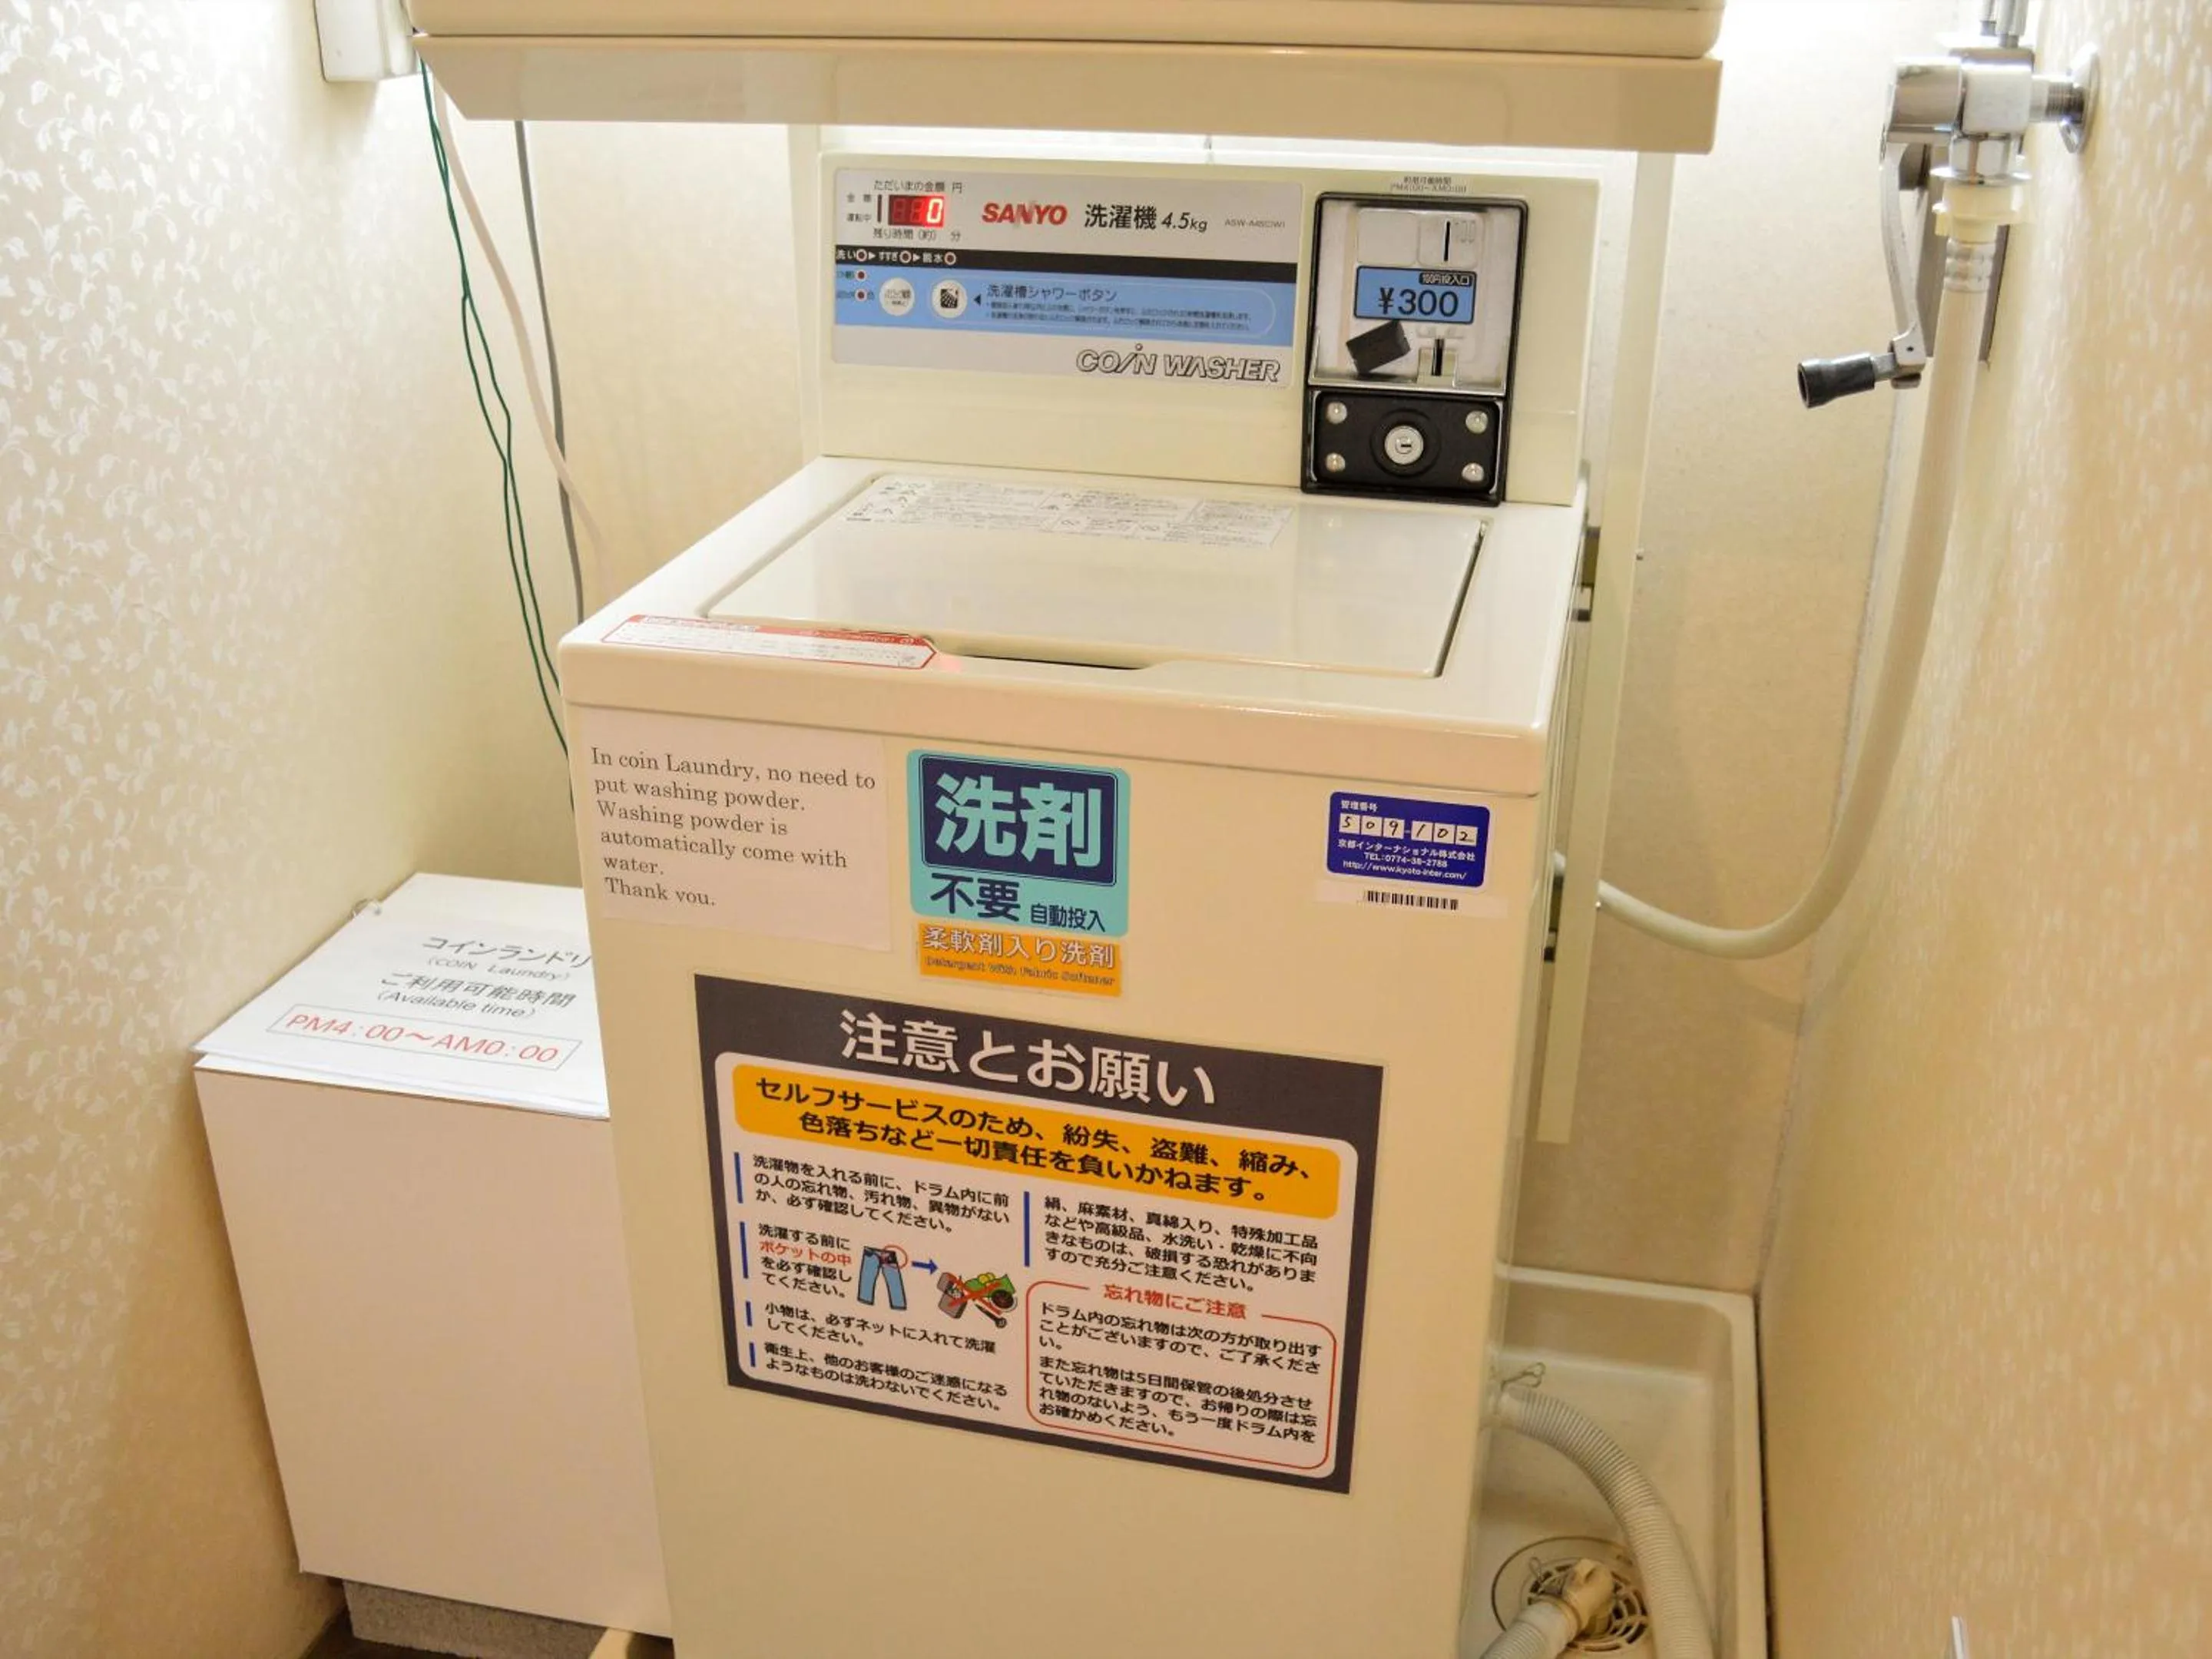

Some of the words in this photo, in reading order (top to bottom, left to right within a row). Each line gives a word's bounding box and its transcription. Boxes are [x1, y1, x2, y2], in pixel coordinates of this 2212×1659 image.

[952, 182, 962, 194] 円
[927, 198, 944, 224] 0
[982, 202, 1068, 226] SANYO
[1084, 204, 1157, 230] 洗濯機
[1161, 212, 1208, 233] 4.5kg
[1378, 286, 1459, 318] ¥300
[1164, 354, 1281, 382] WASHER
[591, 747, 612, 766] In
[619, 752, 658, 770] coin
[667, 753, 760, 782] Laundry,
[768, 768, 791, 782] no
[800, 769, 848, 786] need
[856, 773, 876, 790] to
[594, 777, 628, 794] put
[634, 781, 717, 805] washing
[724, 790, 805, 811] powder.
[597, 800, 683, 829] Washing
[690, 811, 764, 833] powder
[771, 818, 788, 835] is
[935, 772, 1102, 867] 洗剤
[601, 830, 736, 859] automatically
[743, 847, 794, 863] come
[802, 849, 848, 869] with
[603, 856, 664, 875] water.
[1338, 839, 1475, 862] 京都インターナショナル株式会社
[604, 877, 668, 900] Thank
[676, 891, 716, 907] you.
[930, 873, 1021, 922] 不要
[1031, 903, 1106, 932] 自動投入
[924, 926, 1114, 969] 柔軟剤入り洗剤
[377, 992, 477, 1012] (Available
[481, 1002, 536, 1018] time)
[382, 972, 577, 1008] ご利用可能時間
[839, 1008, 1216, 1108] 注意とお願い
[756, 1078, 1310, 1179] セルフサービスのため、紛失、盗難、縮み、
[800, 1111, 1265, 1202] 色落ちなど一切責任を負いかねます。
[753, 1154, 1010, 1208] 洗濯物を入れる前に、ドラム内に前
[754, 1172, 1010, 1224] の人の忘れ物、汚れ物、異物がない
[755, 1188, 952, 1233] か、必ず確認してください。
[758, 1223, 851, 1250] 洗濯する前に
[759, 1240, 852, 1265] ポケットの中
[761, 1256, 853, 1283] を必ず確認し
[1045, 1230, 1316, 1283] きなものは、破損する恐れがありま
[1046, 1247, 1255, 1292] すので充分ご注意ください。
[762, 1272, 846, 1298] てください。
[1103, 1283, 1249, 1320] 忘れ物にご注意
[765, 1302, 997, 1355] 小物は、必ずネットに入れて洗濯
[767, 1319, 865, 1347] してください。
[1040, 1336, 1063, 1351] い。
[1040, 1319, 1321, 1375] ことがございますので、ご了承くださ
[1041, 1301, 1323, 1357] ドラム内の忘れ物は次の方が取り出す
[763, 1341, 1008, 1397] 衛生上、他のお客様のご迷惑になる
[766, 1359, 1002, 1412] ようなものは洗わないでください。
[1039, 1355, 1313, 1410] また忘れ物は5日間保管の後処分させ
[1039, 1386, 1316, 1444] れ物のないよう、もう一度ドラム内を
[1041, 1371, 1318, 1427] ていただきますので、お帰りの際は忘
[1039, 1402, 1176, 1437] お確かめください。
